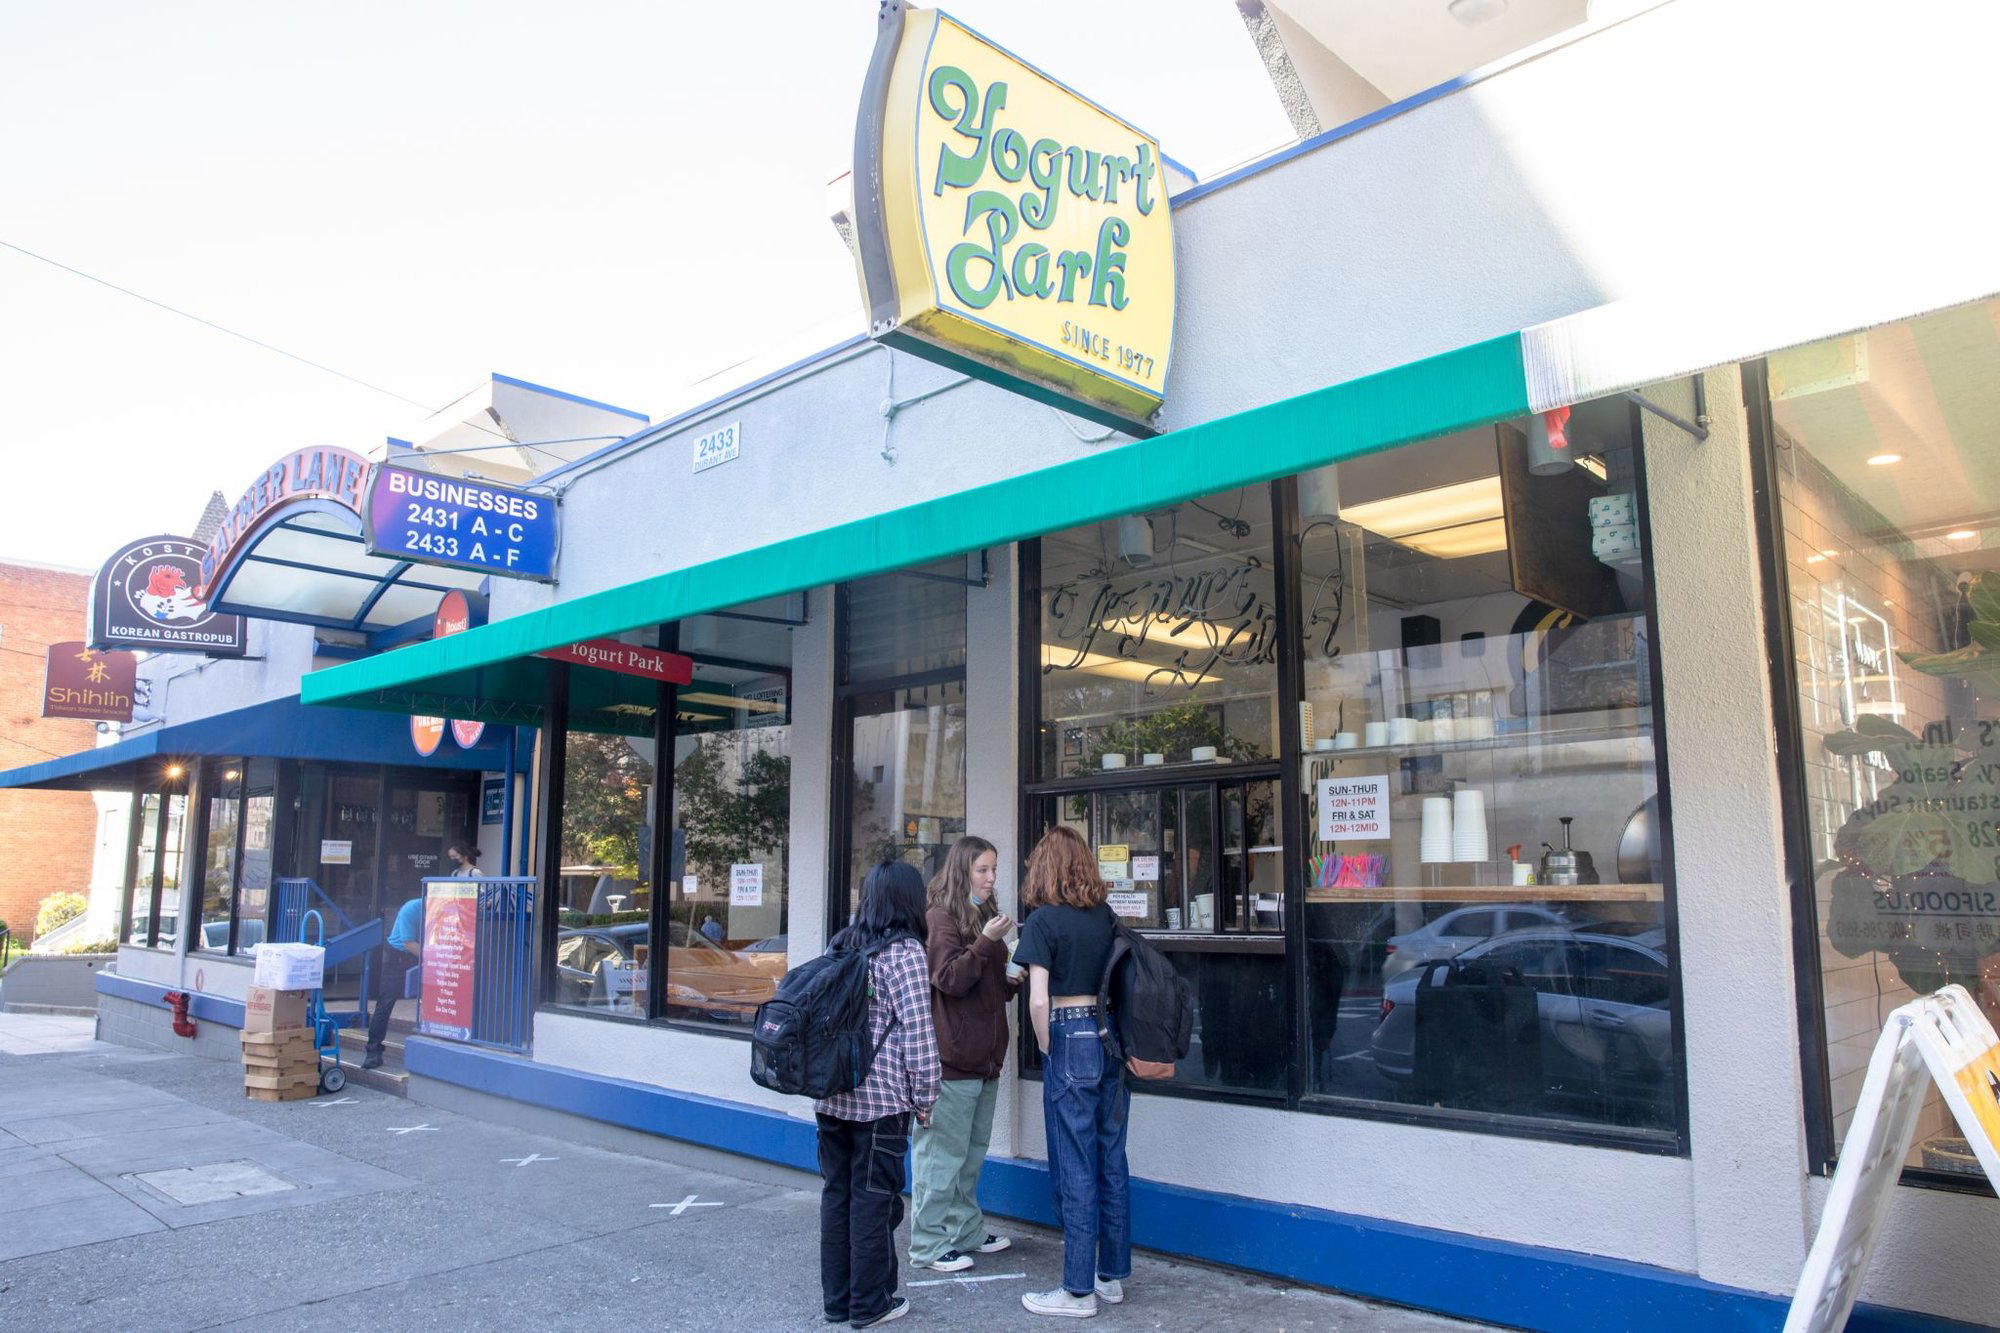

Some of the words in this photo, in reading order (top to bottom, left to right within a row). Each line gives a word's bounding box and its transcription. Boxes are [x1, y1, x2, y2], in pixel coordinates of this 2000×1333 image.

[929, 65, 1155, 230] Yogurt
[946, 190, 1130, 311] Park
[1063, 321, 1110, 361] SINCE
[1117, 345, 1154, 379] 1977
[700, 428, 733, 458] 2433
[292, 452, 363, 507] LANE
[389, 473, 538, 520] BUSINESSES
[407, 503, 458, 531] 2431
[471, 516, 487, 536] A
[508, 523, 523, 542] C
[125, 544, 194, 566] KOST
[405, 530, 459, 557] 2433
[469, 542, 486, 562] A
[507, 548, 520, 566] F
[112, 626, 160, 639] KOREAN
[164, 629, 233, 643] GASTROPUB
[570, 642, 623, 664] Yogurt
[628, 651, 664, 673] Park
[48, 687, 129, 707] Shihlin
[1328, 784, 1378, 796] SUN-THUR
[1331, 797, 1376, 807] 12N-11PM
[1330, 823, 1379, 833] 12N-12MID
[1332, 811, 1347, 821] FRI
[1349, 811, 1356, 820] &
[1358, 810, 1376, 820] SAT
